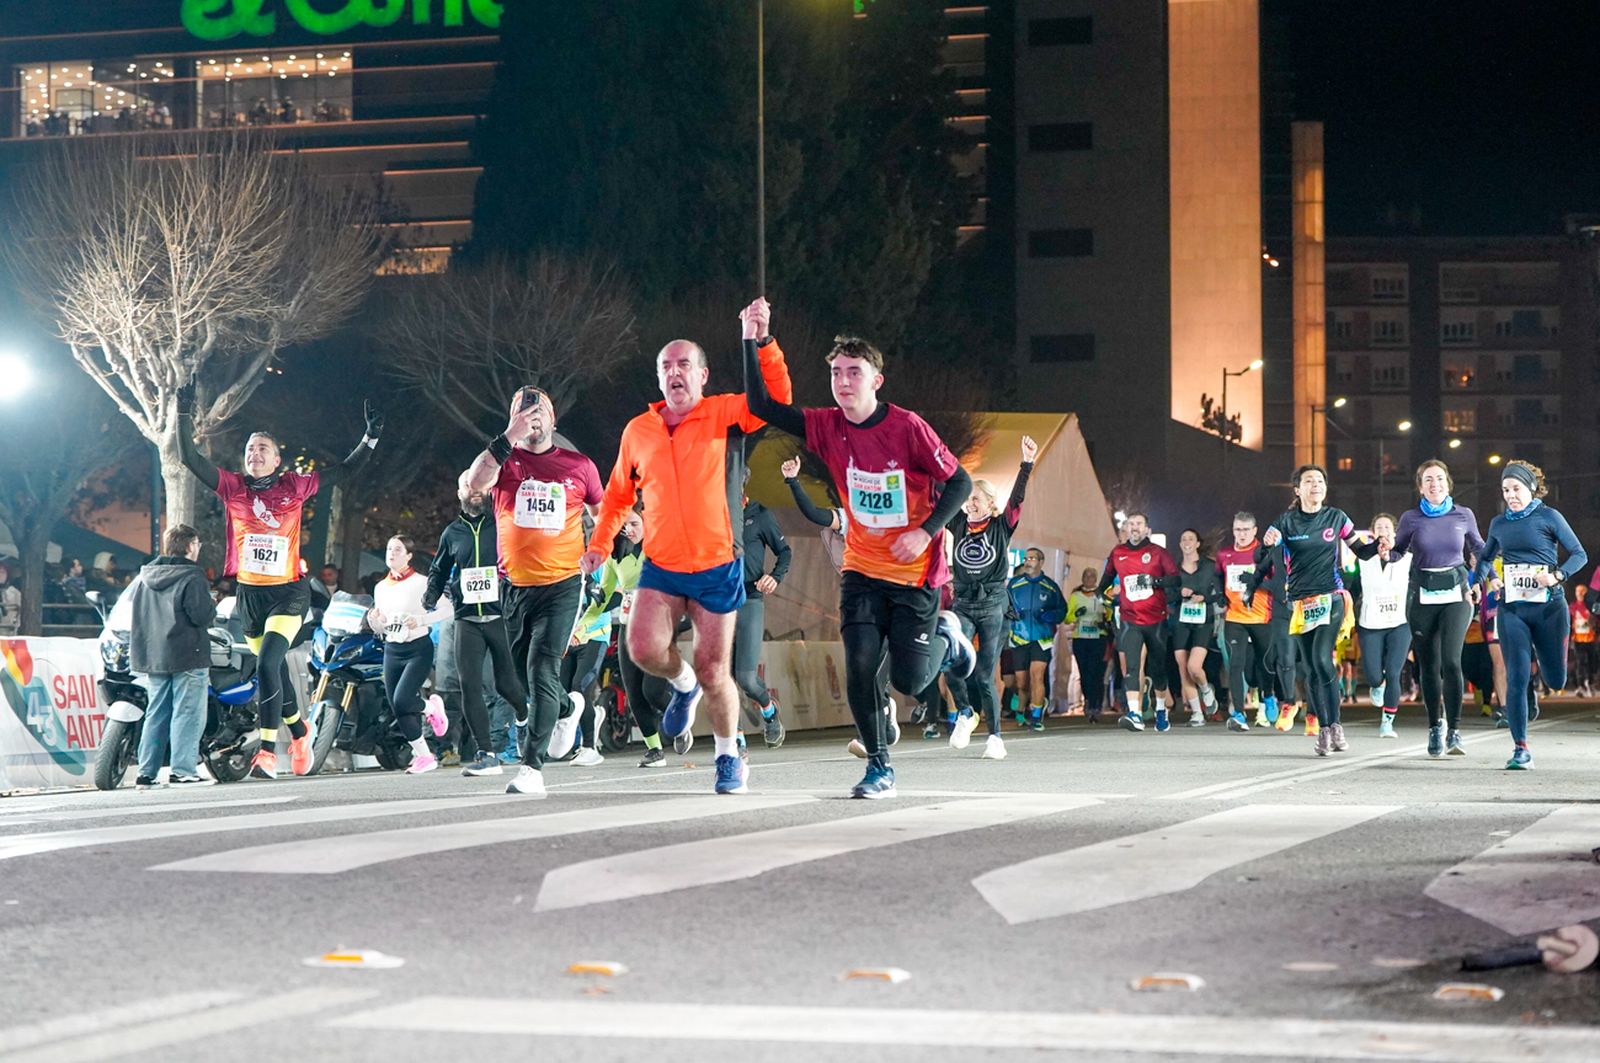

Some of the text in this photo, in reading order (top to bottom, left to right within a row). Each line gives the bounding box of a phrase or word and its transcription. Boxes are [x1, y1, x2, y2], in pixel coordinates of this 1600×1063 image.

[526, 497, 556, 513] 1454
[859, 490, 893, 509] 2128
[252, 547, 278, 562] 1621
[466, 579, 491, 592] 6226
[1304, 606, 1326, 620] 8452
[53, 674, 97, 709] SAN
[27, 692, 57, 747] 43
